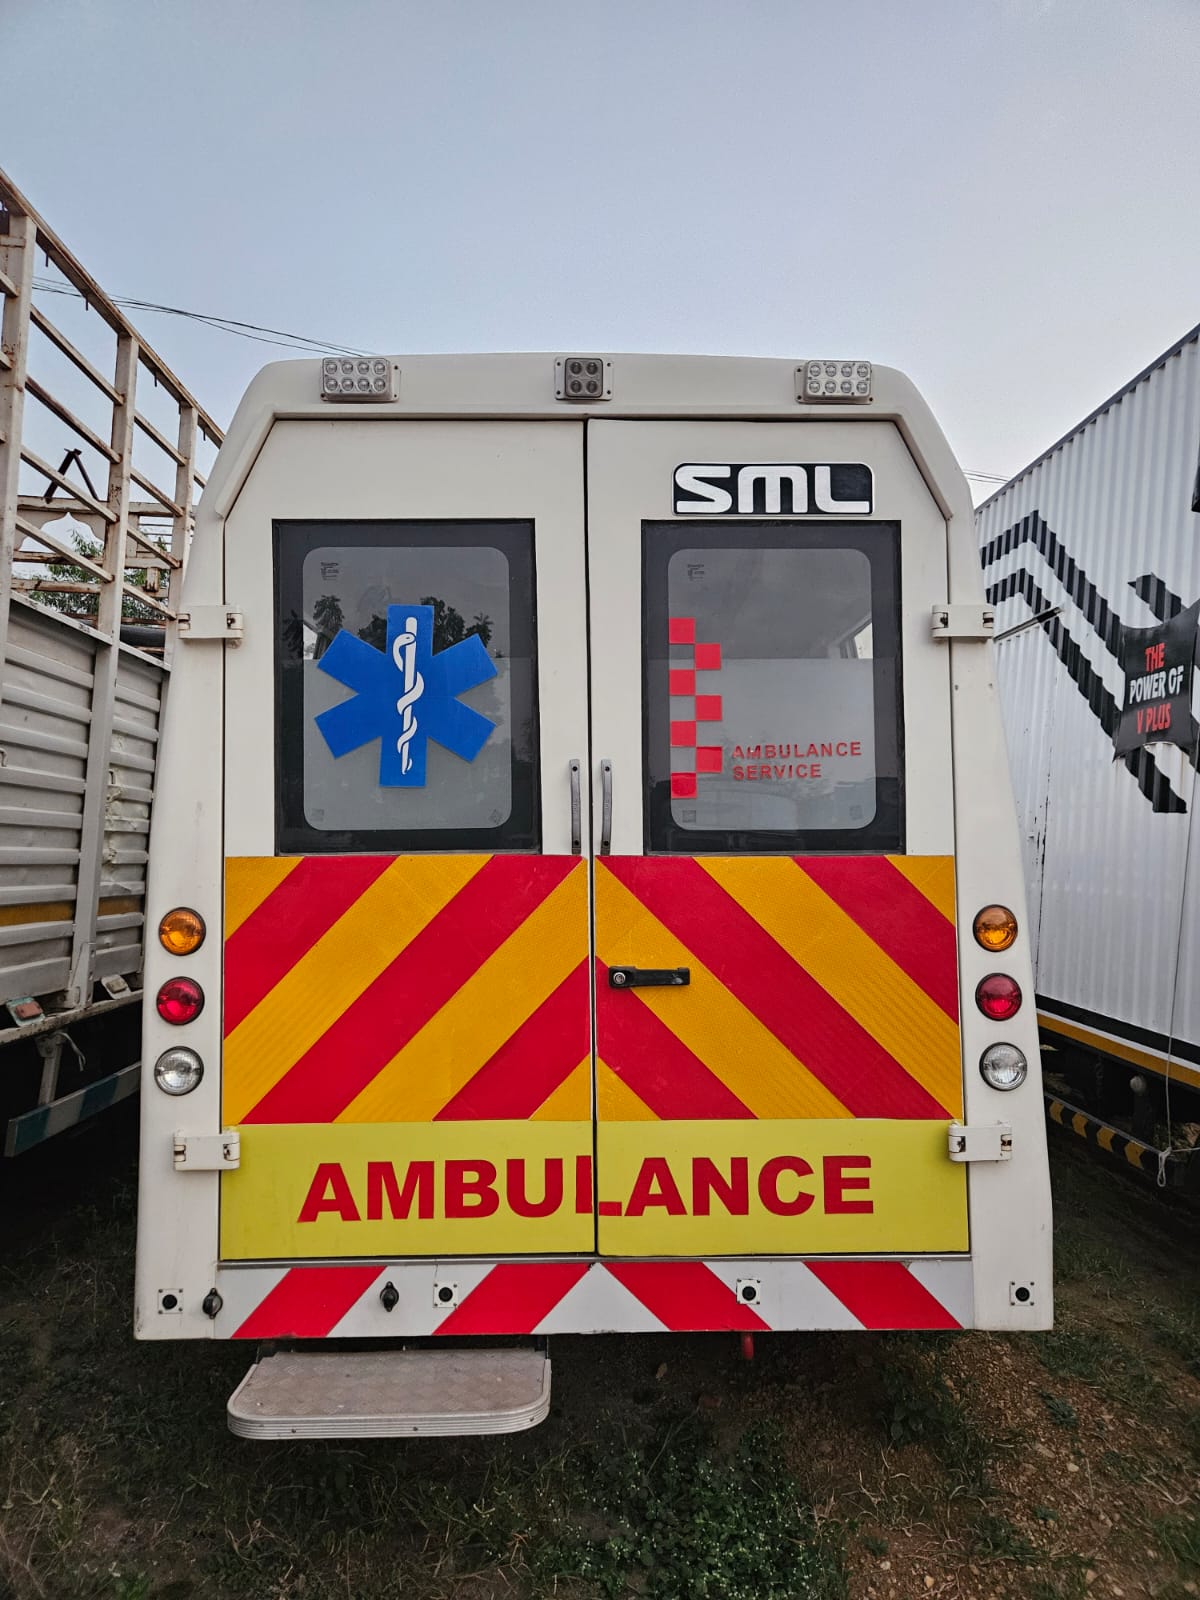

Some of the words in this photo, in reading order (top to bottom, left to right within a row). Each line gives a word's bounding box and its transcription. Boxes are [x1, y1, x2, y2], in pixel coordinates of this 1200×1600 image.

[675, 465, 870, 513] SML
[1145, 643, 1165, 672] THE
[1129, 671, 1167, 704] POWER
[1168, 665, 1184, 695] OF
[1137, 709, 1144, 734] V
[1146, 703, 1171, 733] PLUS
[732, 741, 862, 760] AMBULANCE
[733, 763, 822, 780] SERVICE
[297, 1155, 874, 1223] AMBULANCE
